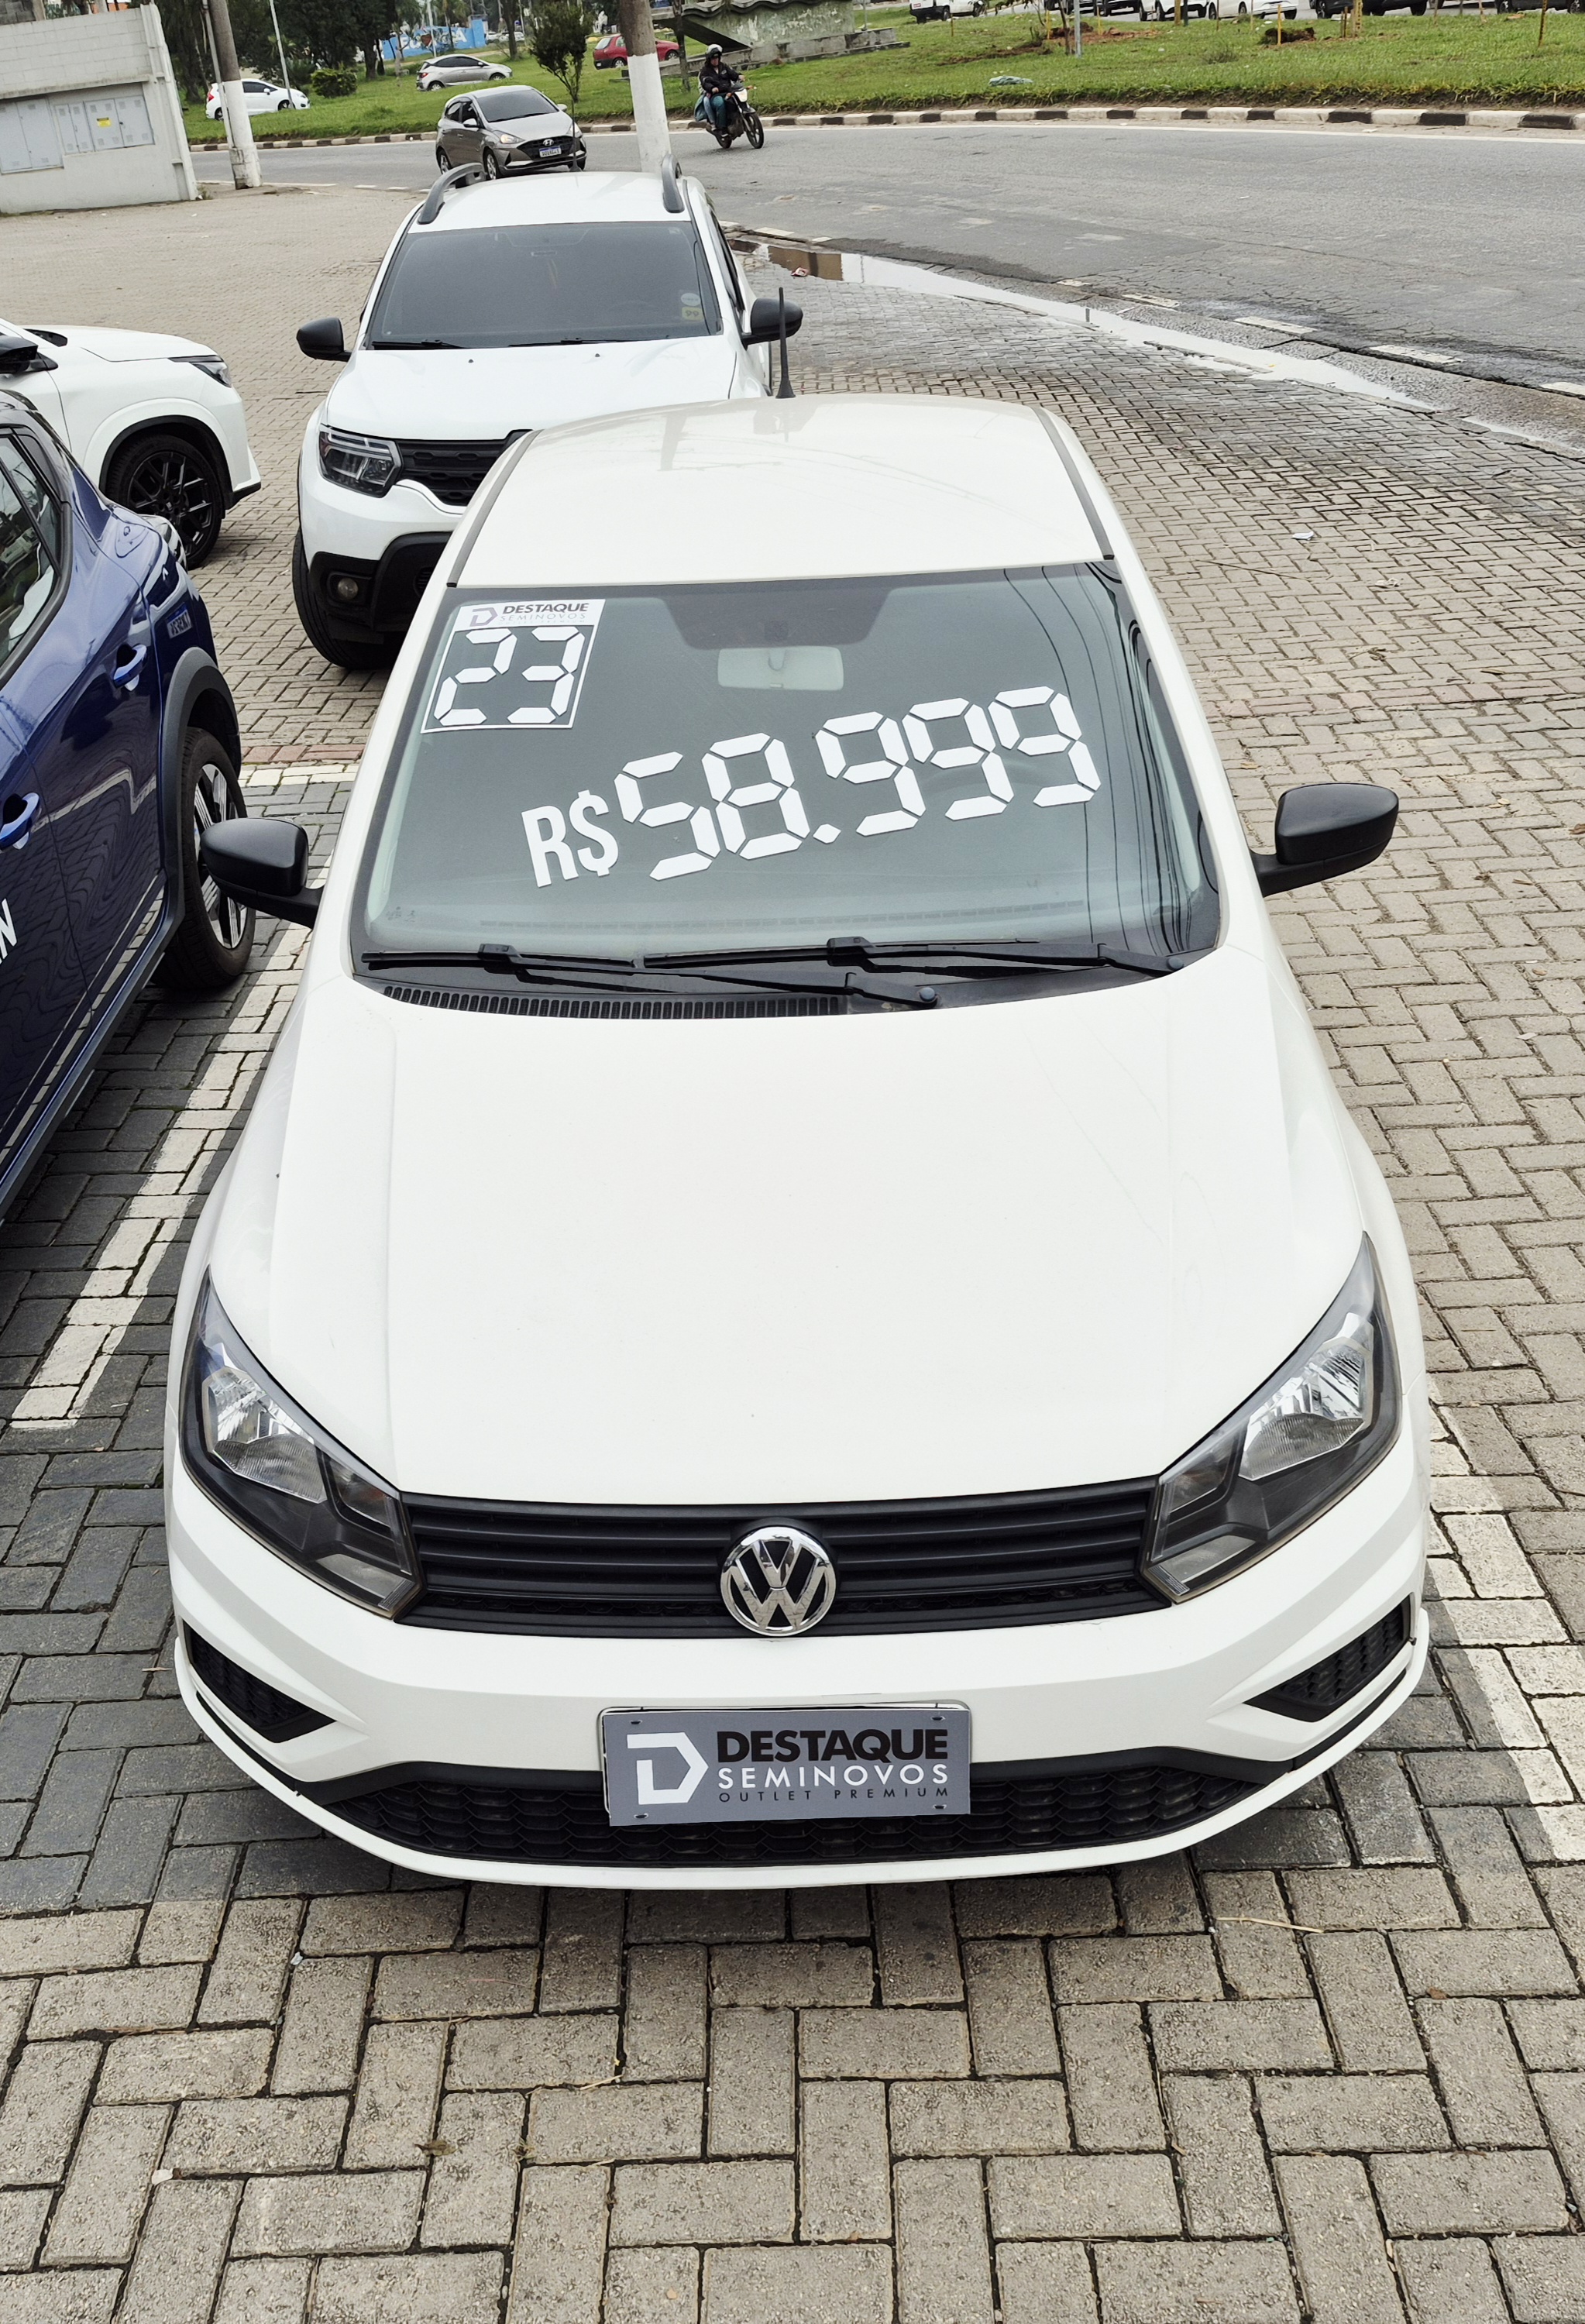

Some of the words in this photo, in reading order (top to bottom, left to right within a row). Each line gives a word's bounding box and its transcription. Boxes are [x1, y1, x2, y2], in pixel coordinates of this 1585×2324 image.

[500, 613, 586, 621] SEMINOVOS
[503, 603, 589, 614] DESTAQUE
[434, 626, 586, 727] 23
[521, 686, 1102, 889] R$58.999
[717, 1728, 948, 1763] DESTAQUE
[717, 1763, 948, 1790] SEMINOVOS
[719, 1789, 812, 1803] OUTLET
[834, 1787, 949, 1800] PREMIUM
